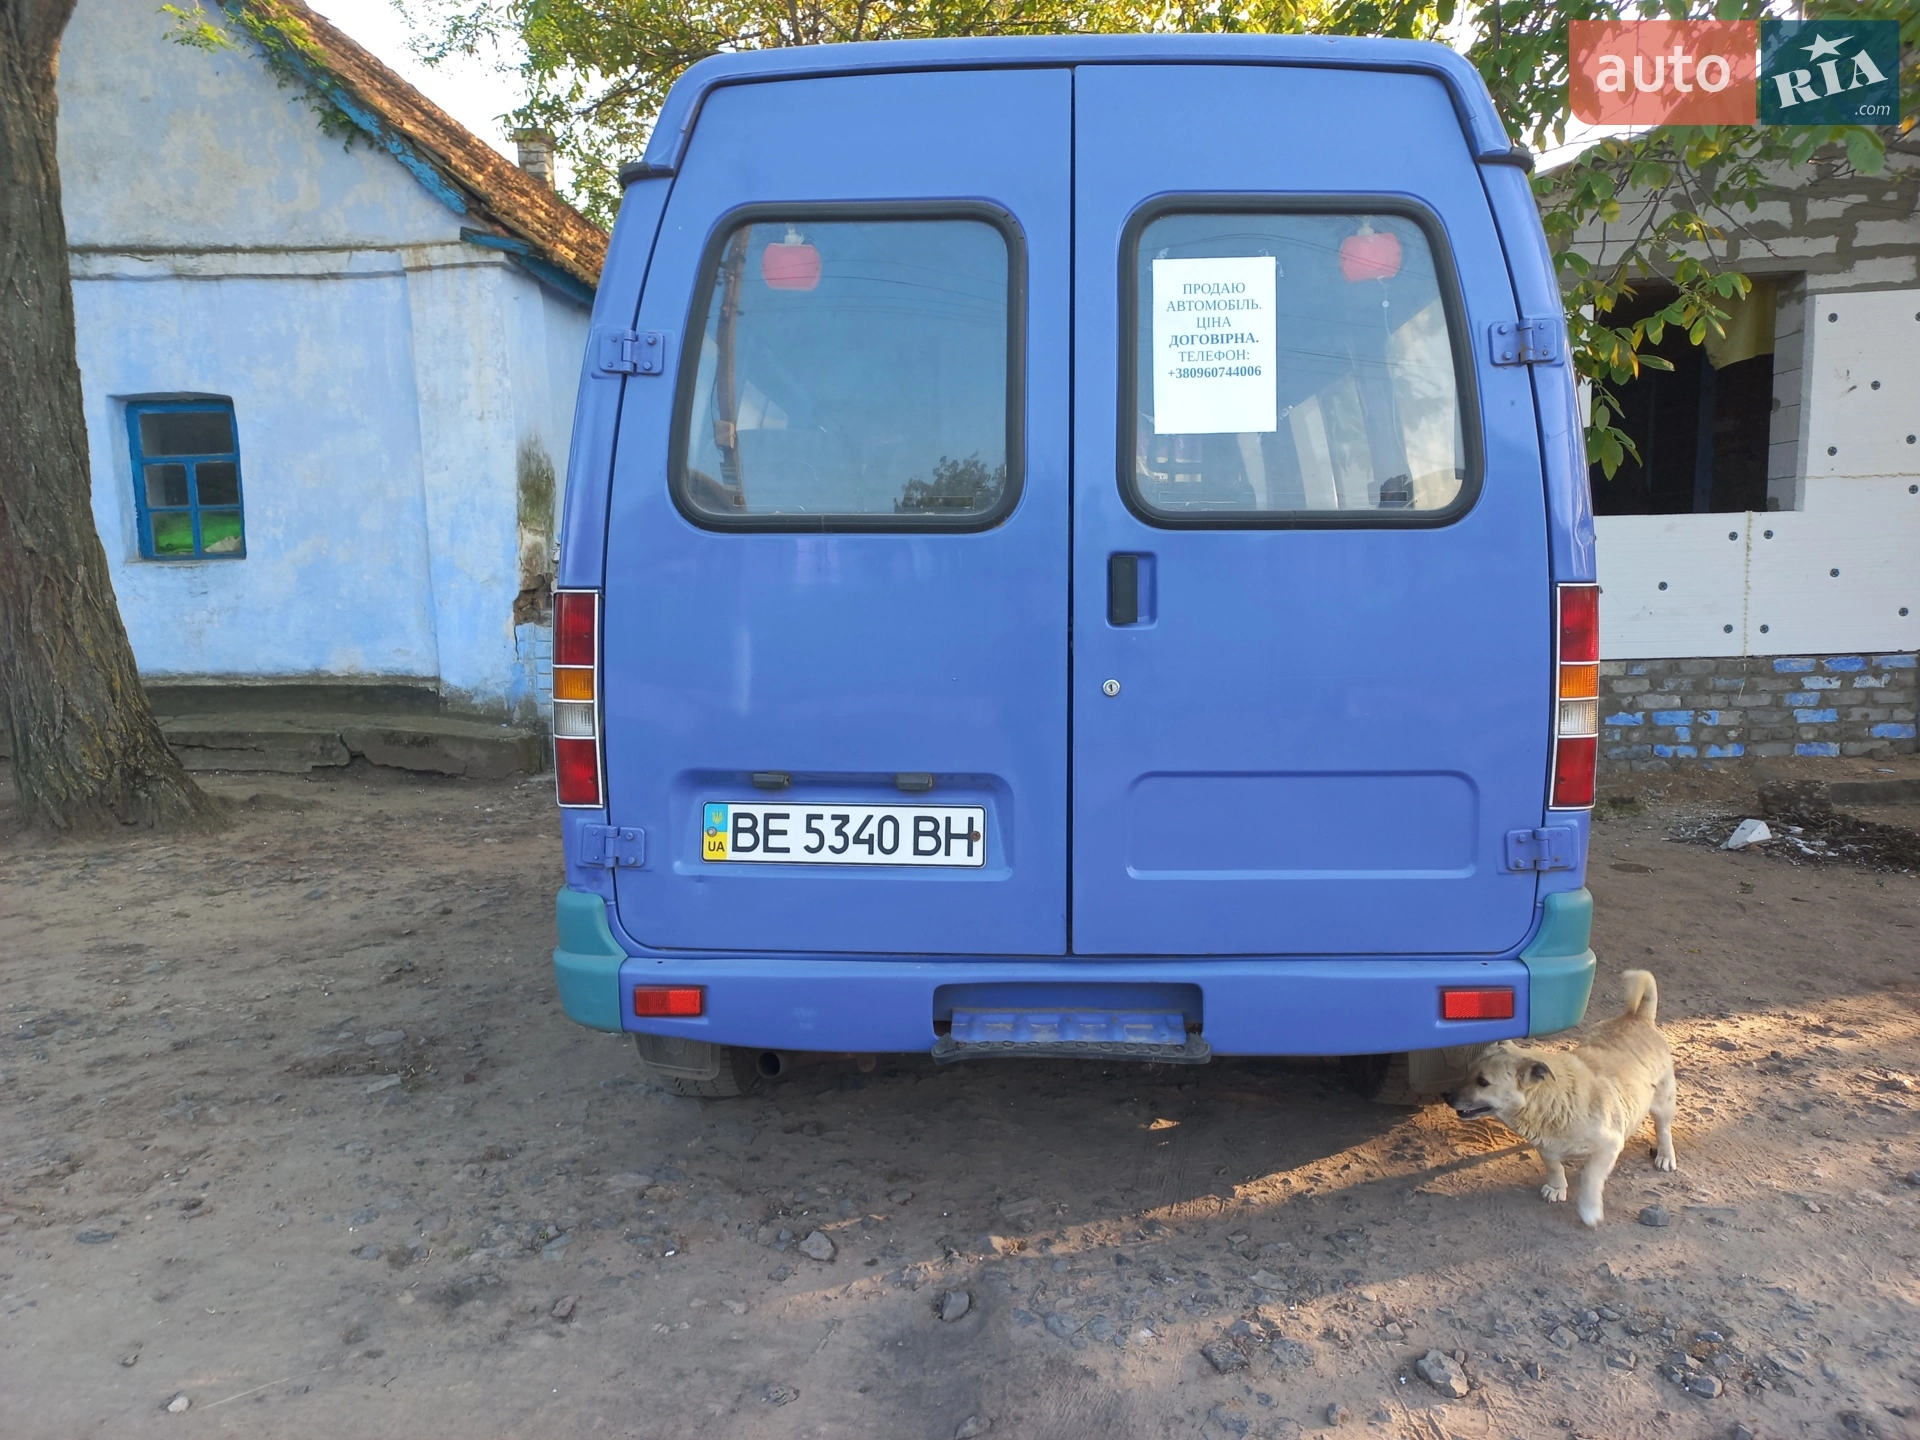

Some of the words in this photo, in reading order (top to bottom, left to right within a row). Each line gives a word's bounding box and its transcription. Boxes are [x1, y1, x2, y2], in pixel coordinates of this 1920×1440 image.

[1182, 282, 1246, 296] ПРОДАЮ
[1166, 299, 1262, 312] АВТОМОБІЛЬ.
[1196, 316, 1232, 330] ЦІНА
[1168, 332, 1259, 348] ДОГОВІРНА.
[1178, 349, 1250, 362] ТЕЛЕФОН:
[1168, 365, 1262, 379] +380960744006
[731, 812, 791, 854] BE
[803, 813, 900, 855] 5340
[912, 815, 974, 857] BH
[707, 841, 725, 852] UA
